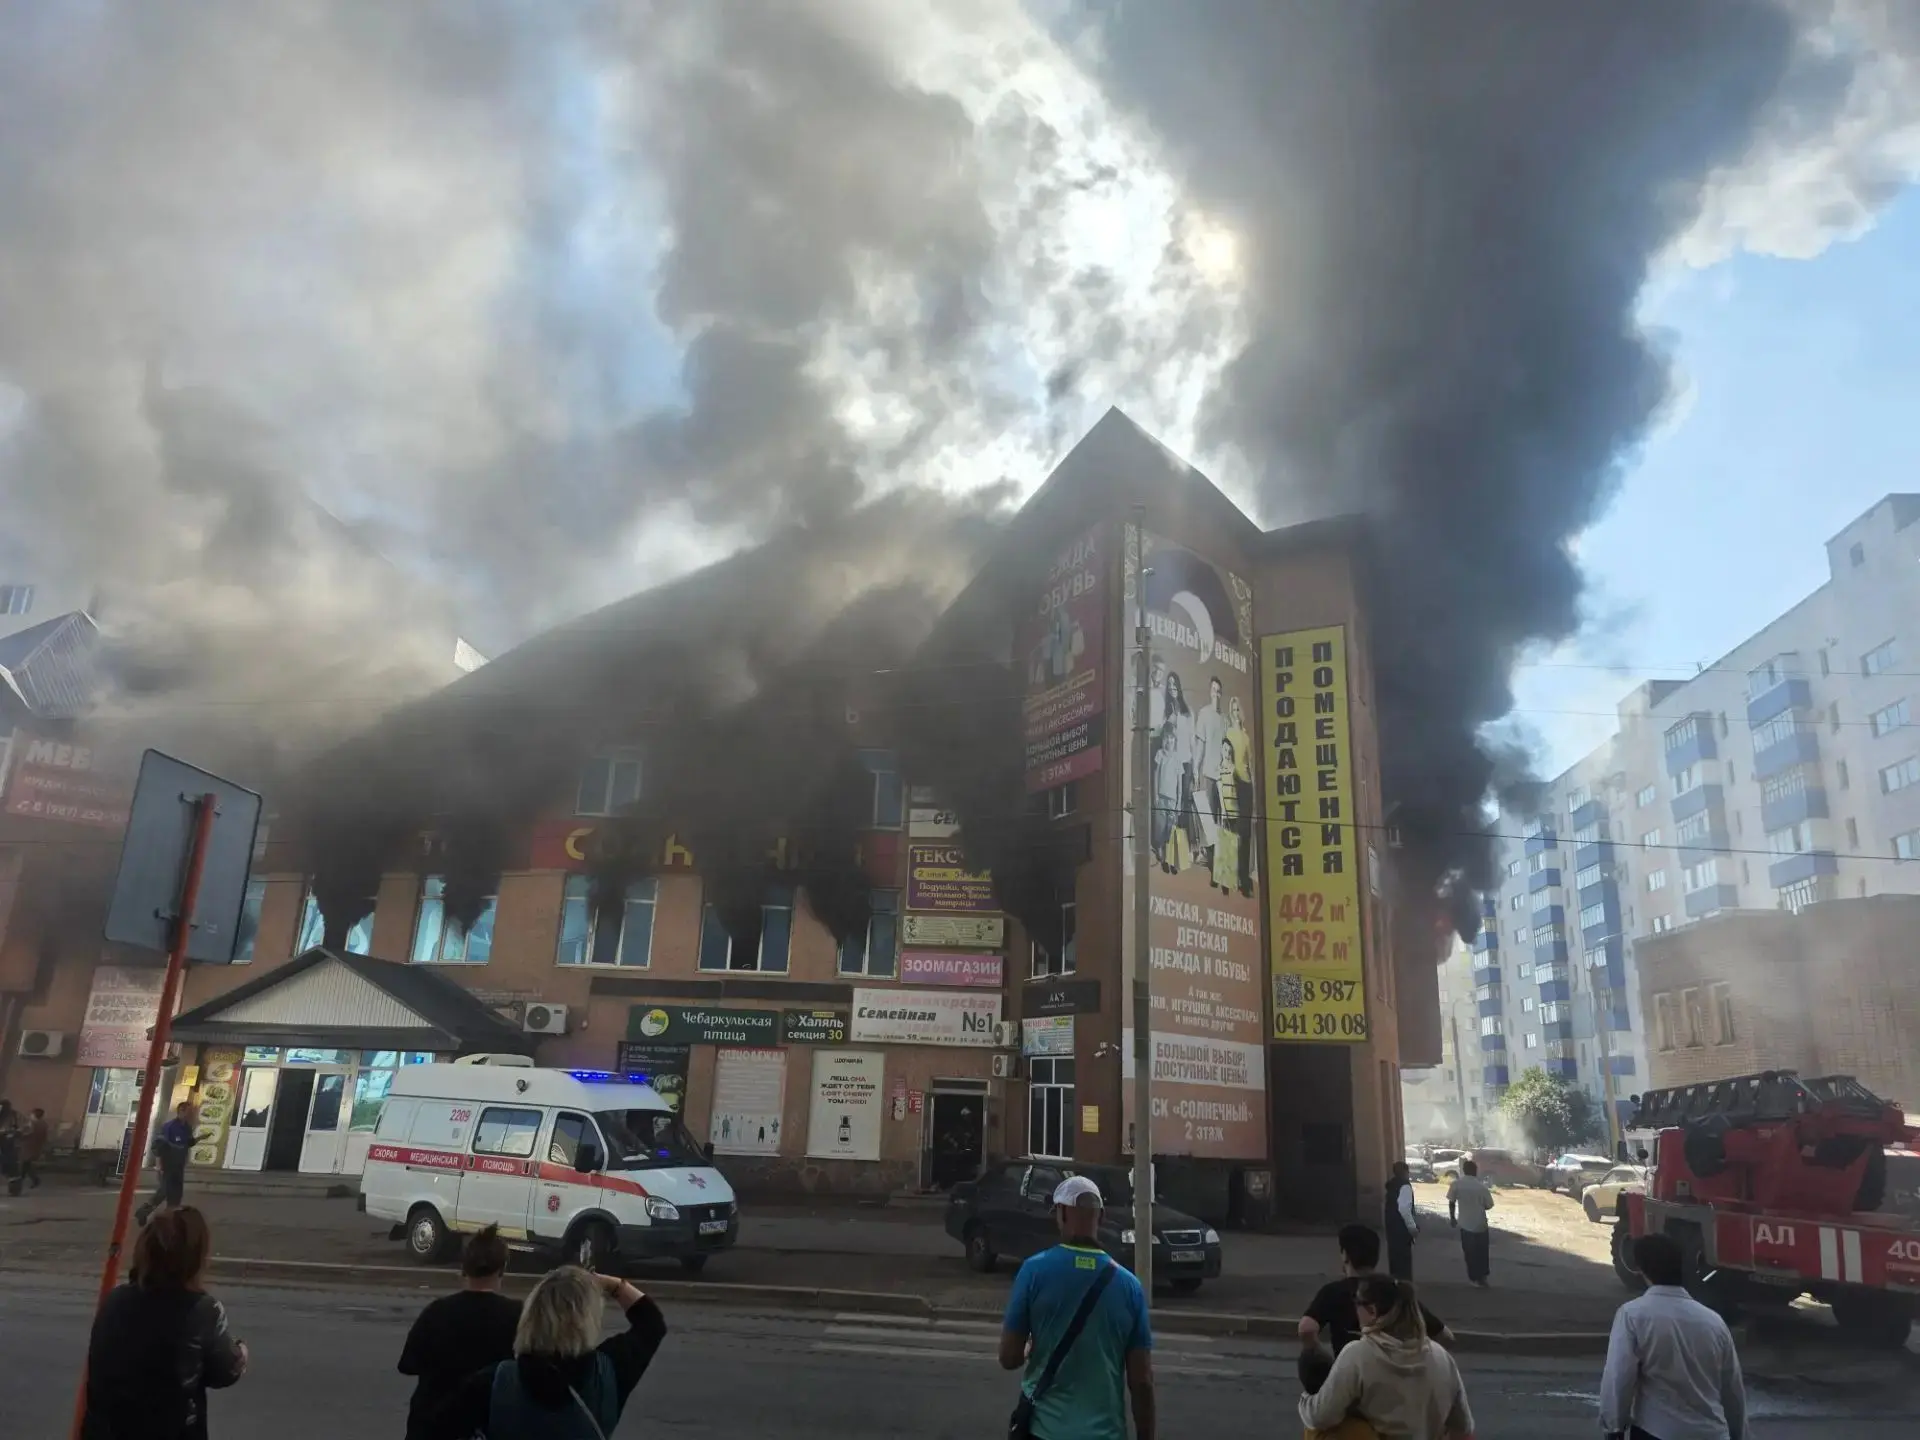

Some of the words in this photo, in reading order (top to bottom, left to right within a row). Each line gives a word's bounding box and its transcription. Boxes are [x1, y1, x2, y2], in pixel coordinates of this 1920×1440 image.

[1039, 570, 1096, 615] ОБУВЬ
[1214, 640, 1247, 673] ОБУВИ
[25, 740, 92, 769] МЕБ
[1274, 647, 1303, 877] ПРОДАЮТСЯ
[1312, 641, 1343, 874] ПОМЕЩЕНИЯ
[1048, 761, 1072, 781] ЭТАЖ
[913, 848, 962, 864] ТЕКС
[1133, 894, 1203, 925] УЖСКАЯ,
[1206, 908, 1257, 938] ЖЕНСКАЯ,
[1279, 892, 1324, 923] 442
[1176, 926, 1228, 955] ДЕТСКАЯ
[1281, 929, 1326, 962] 262
[904, 959, 1001, 974] ЗООМАГАЗИН
[1204, 956, 1212, 975] И
[1214, 959, 1251, 982] ОБУВЬ!
[1196, 989, 1208, 1000] так
[1303, 980, 1315, 1001] 8
[1319, 980, 1356, 1002] 987
[682, 1011, 772, 1027] Чебаркульская
[798, 1015, 844, 1028] Халяль
[857, 1007, 937, 1022] Семейная
[962, 1012, 993, 1032] №1
[1171, 999, 1213, 1017] ИГРУШКИ,
[1215, 1005, 1259, 1023] АКСЕССУАРЫ
[703, 1030, 746, 1041] птица
[787, 1031, 825, 1041] секция
[828, 1030, 843, 1041] 30
[1275, 1012, 1307, 1035] 041
[1313, 1013, 1336, 1035] 30
[1341, 1013, 1365, 1036] 08
[718, 1049, 787, 1061] СПЕЦОДЕЖДА
[1156, 1041, 1209, 1063] БОЛЬШОЙ
[1212, 1047, 1246, 1067] ВЫБОР!
[1154, 1060, 1218, 1081] ДОСТУПНЫЕ
[449, 1109, 471, 1122] 2209
[1152, 1097, 1169, 1117] СК
[1172, 1100, 1253, 1122] «СОЛНЕЧНЫЙ»
[1185, 1121, 1193, 1140] 2
[1196, 1126, 1224, 1141] этаж
[374, 1147, 398, 1160] СКОРАЯ
[409, 1151, 459, 1166] МЕДИЦИНСКАЯ
[482, 1159, 515, 1172] ПОМОЩЬ
[1755, 1223, 1796, 1246] АЛ
